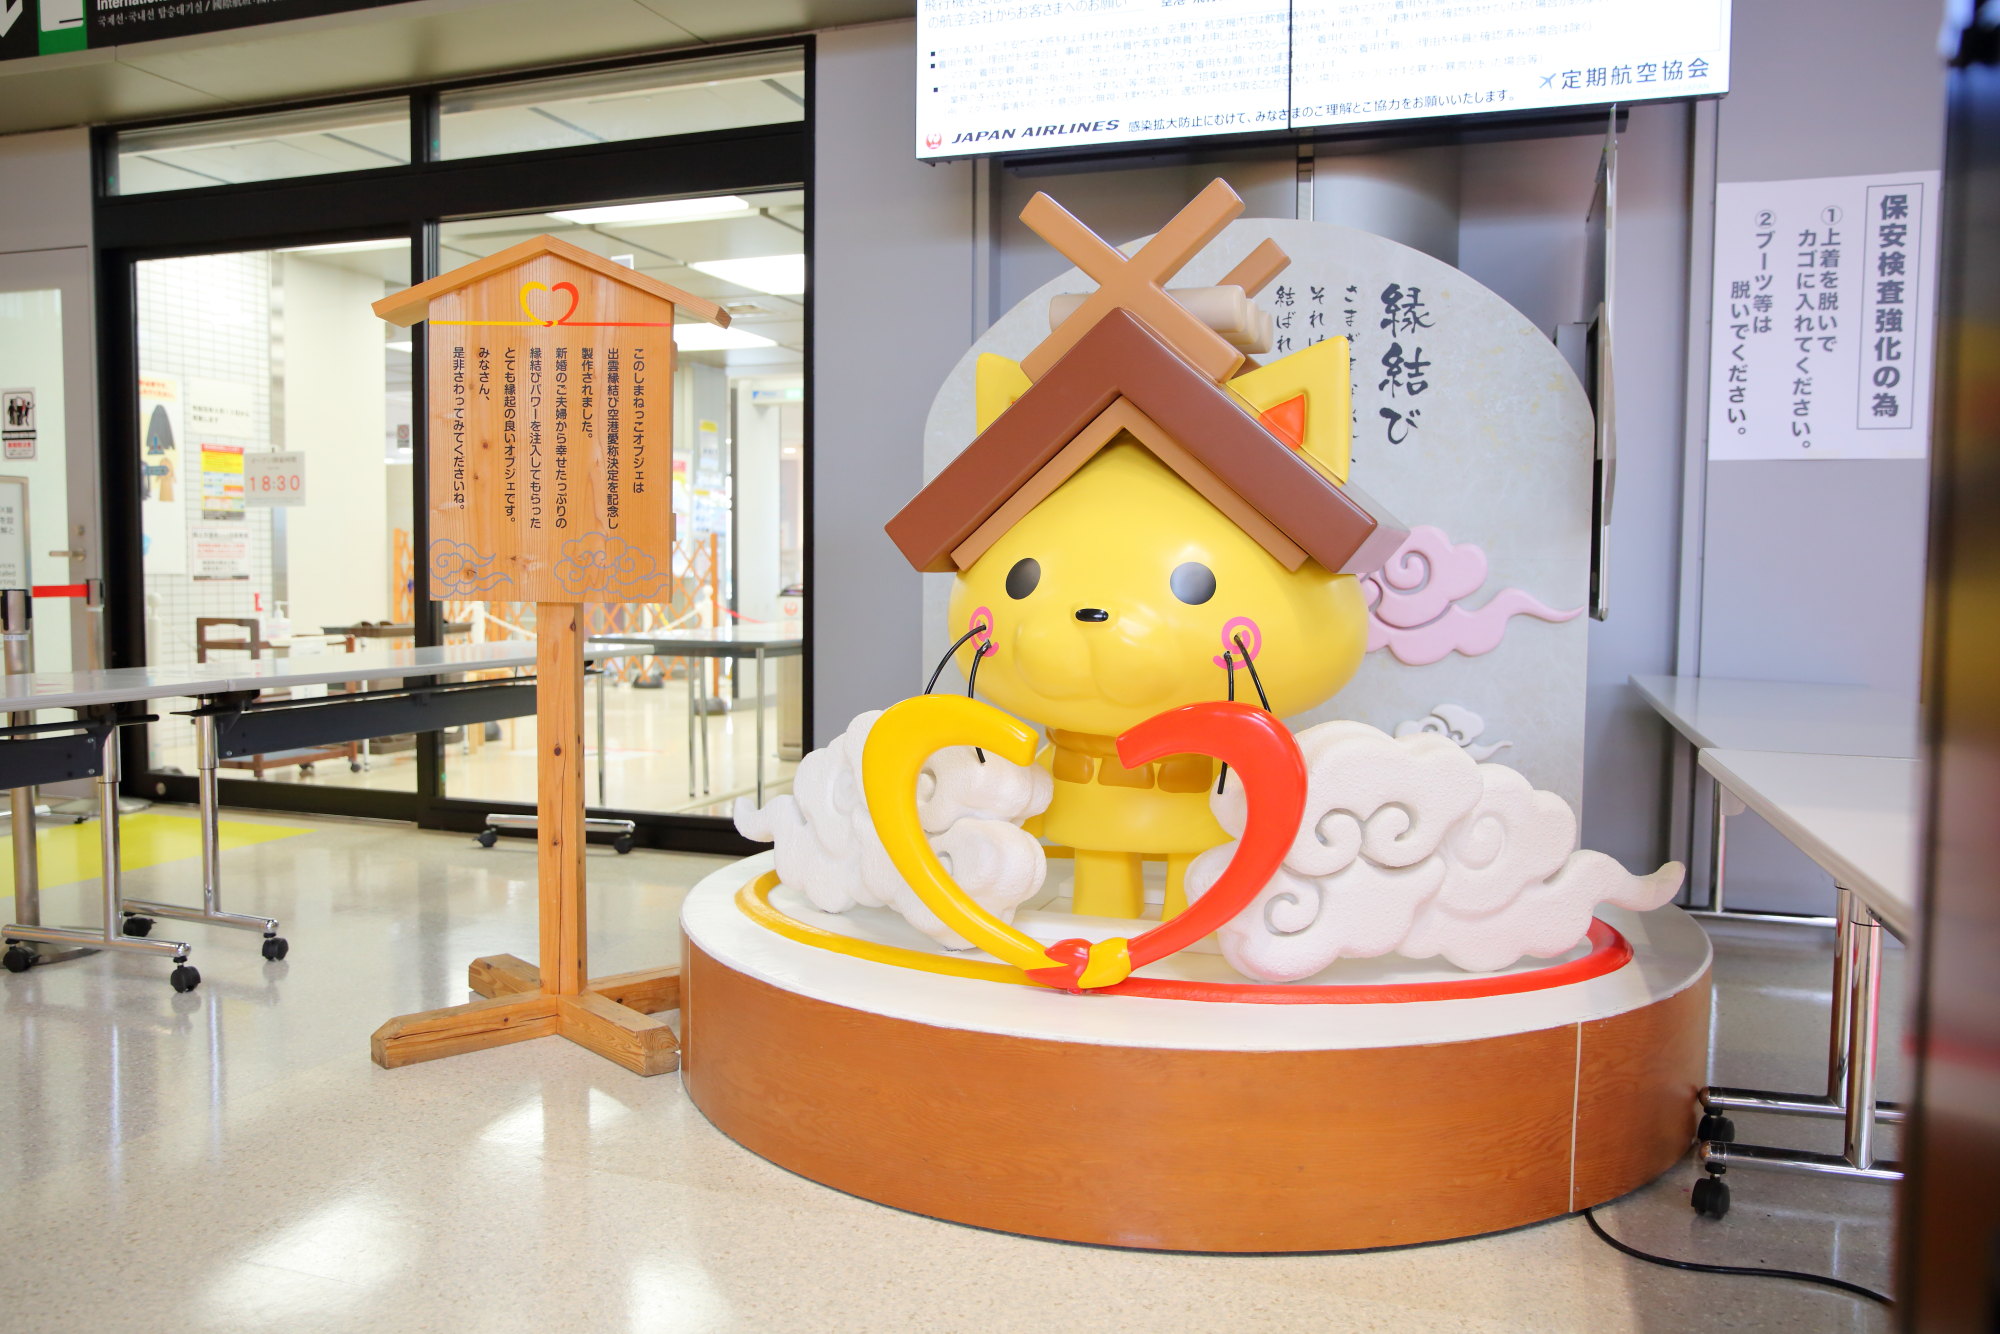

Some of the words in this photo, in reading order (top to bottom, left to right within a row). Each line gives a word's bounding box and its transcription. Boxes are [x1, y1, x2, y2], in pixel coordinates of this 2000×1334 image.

[951, 128, 1015, 144] JAPAN
[1021, 119, 1120, 138] AIRLINES
[1562, 57, 1709, 90] 定期航空協会
[477, 346, 491, 402] みなさん、
[1377, 282, 1436, 446] 縁結び
[1727, 280, 1751, 437] 脱いでください。
[1791, 229, 1818, 450] カゴに入れてください。
[1871, 194, 1909, 418] 保安検査強化の為
[452, 346, 466, 511] 是非さわってみてくださいね。
[503, 346, 517, 524] とても縁起の良いオブジェです。
[529, 346, 543, 530] 縁結びパワーを注入してもらった
[554, 346, 568, 529] 新婚のご夫婦から幸せたっぷりの
[580, 346, 595, 439] 製作されました。
[606, 346, 620, 530] 出雲縁結び空港愛称決定を記念し
[632, 347, 646, 494] このしまねっこオブジェは
[249, 474, 301, 492] 18:30
